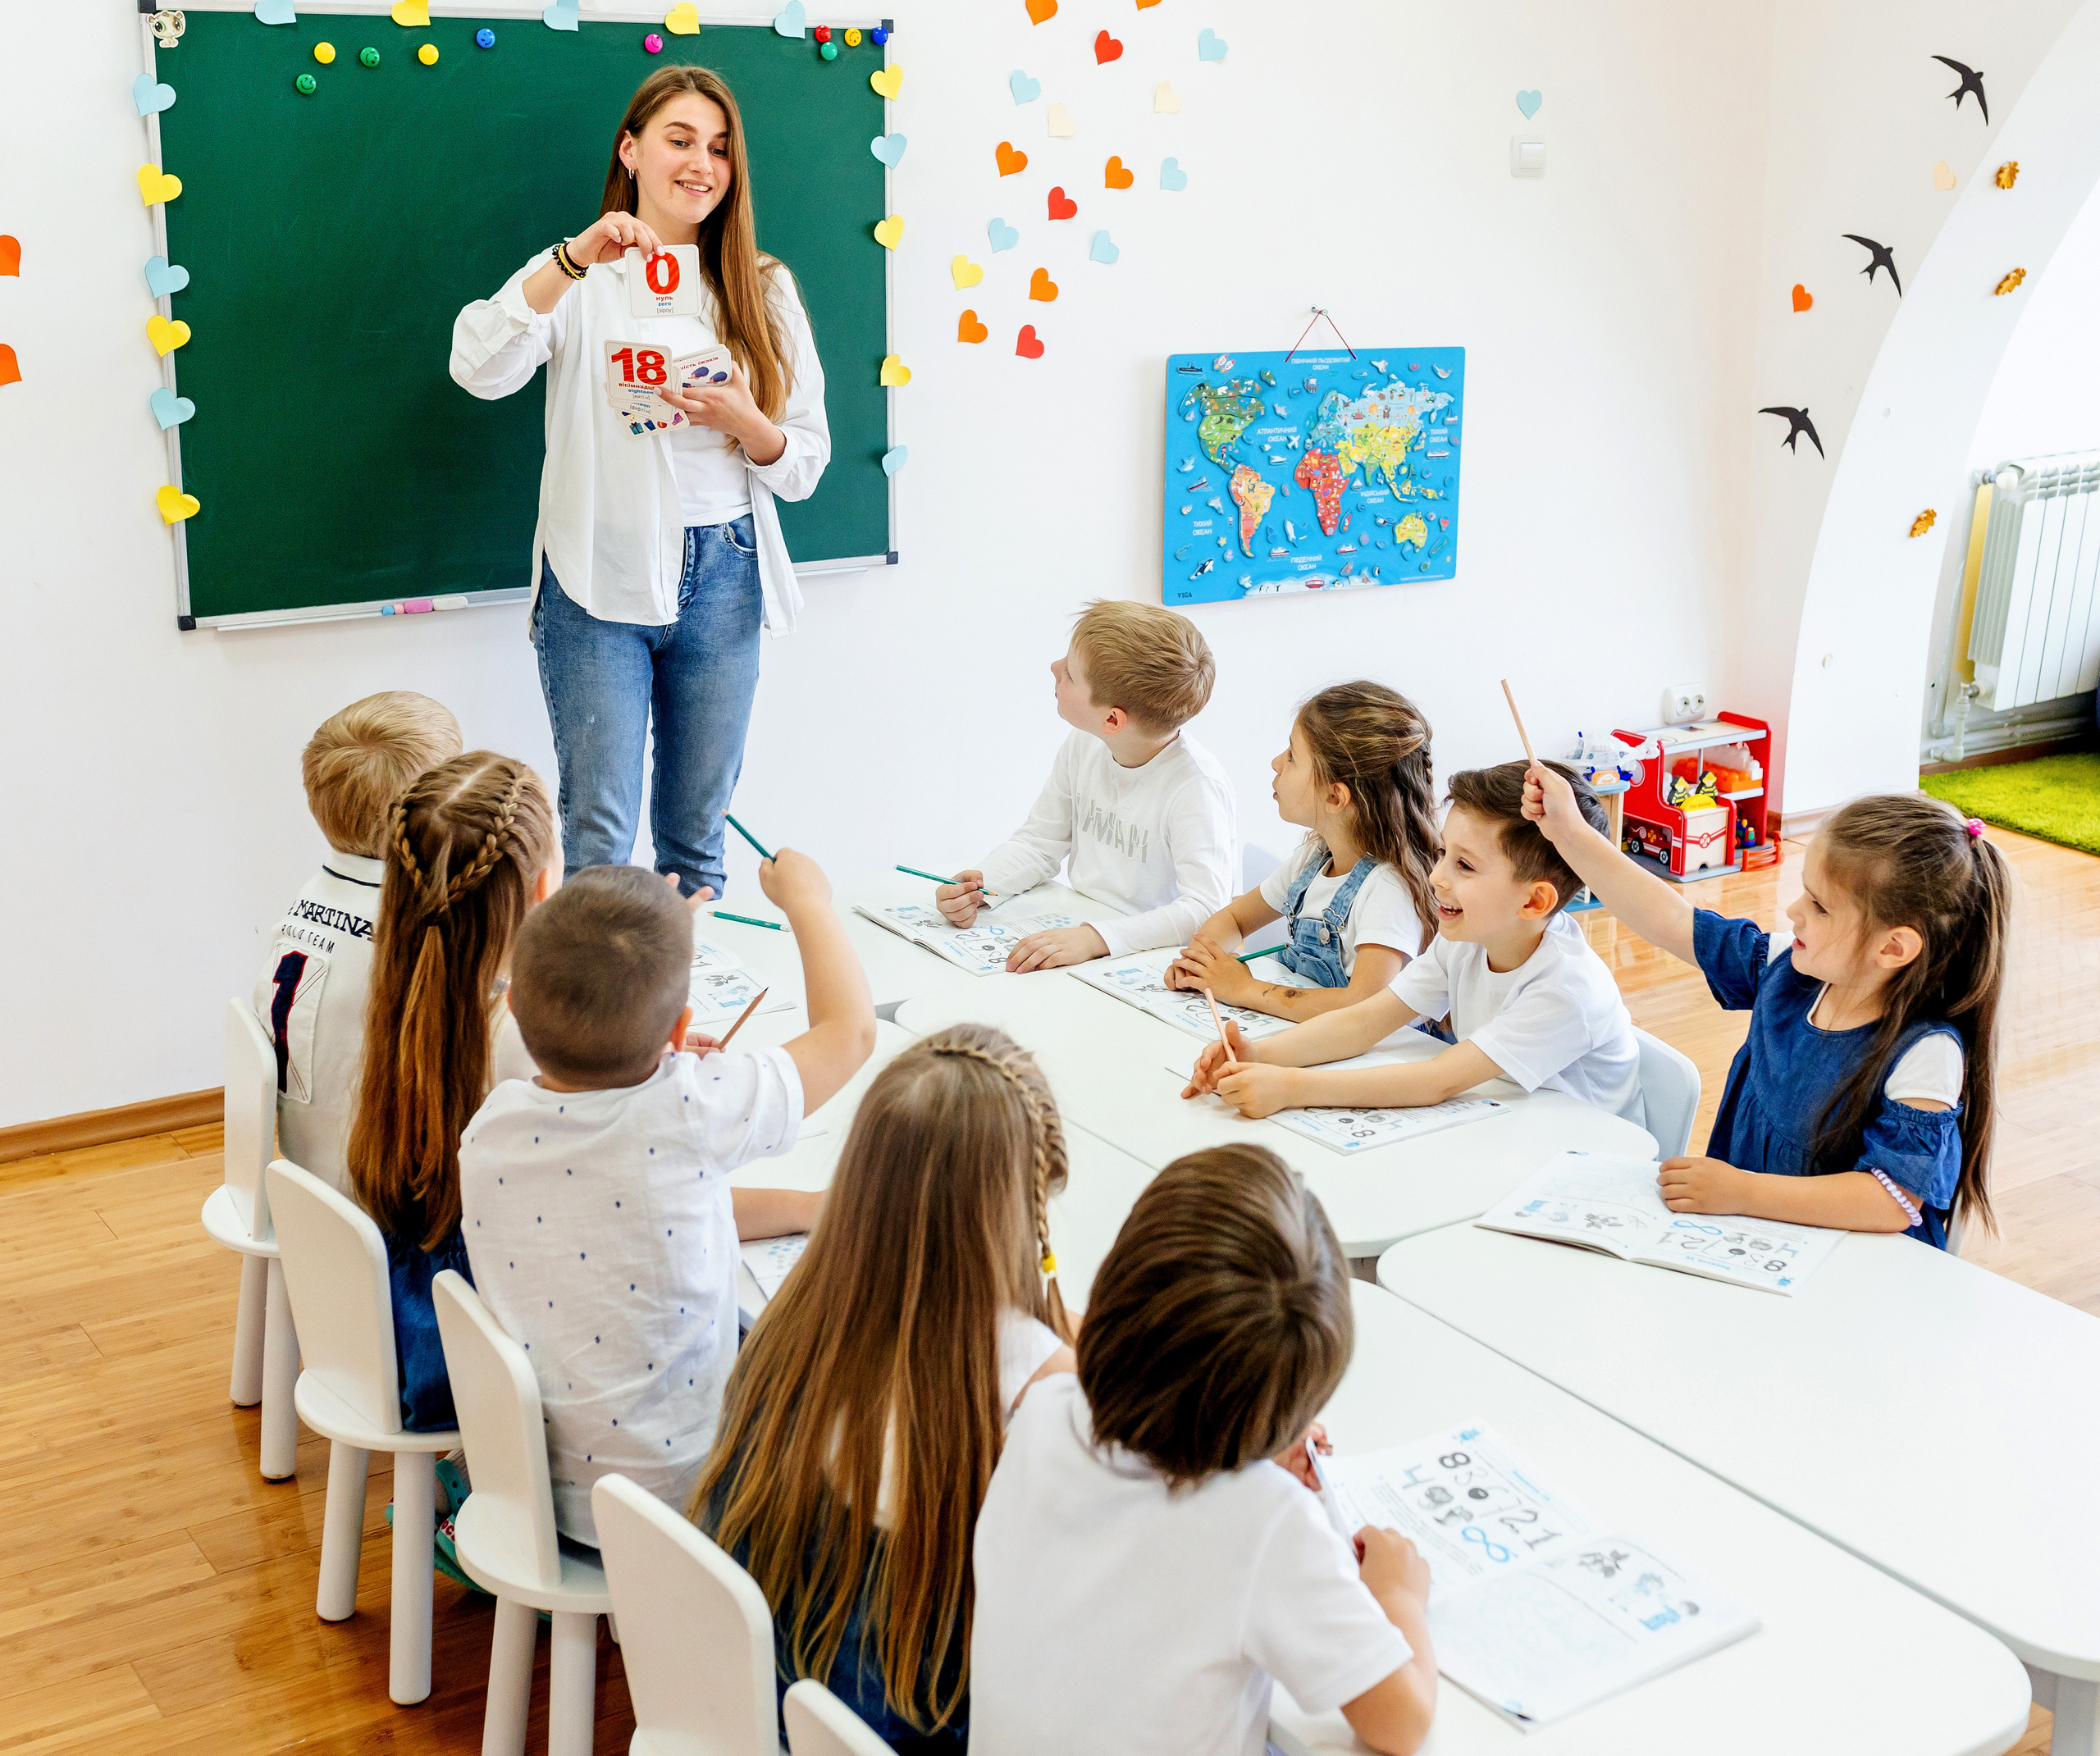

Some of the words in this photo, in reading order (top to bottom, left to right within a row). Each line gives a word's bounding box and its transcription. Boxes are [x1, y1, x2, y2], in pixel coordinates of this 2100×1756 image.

[646, 252, 680, 294] 0
[611, 348, 668, 385] 18
[1193, 519, 1212, 527] ТИХИЙ
[293, 899, 374, 942] MARTINA
[308, 932, 335, 954] TEAM
